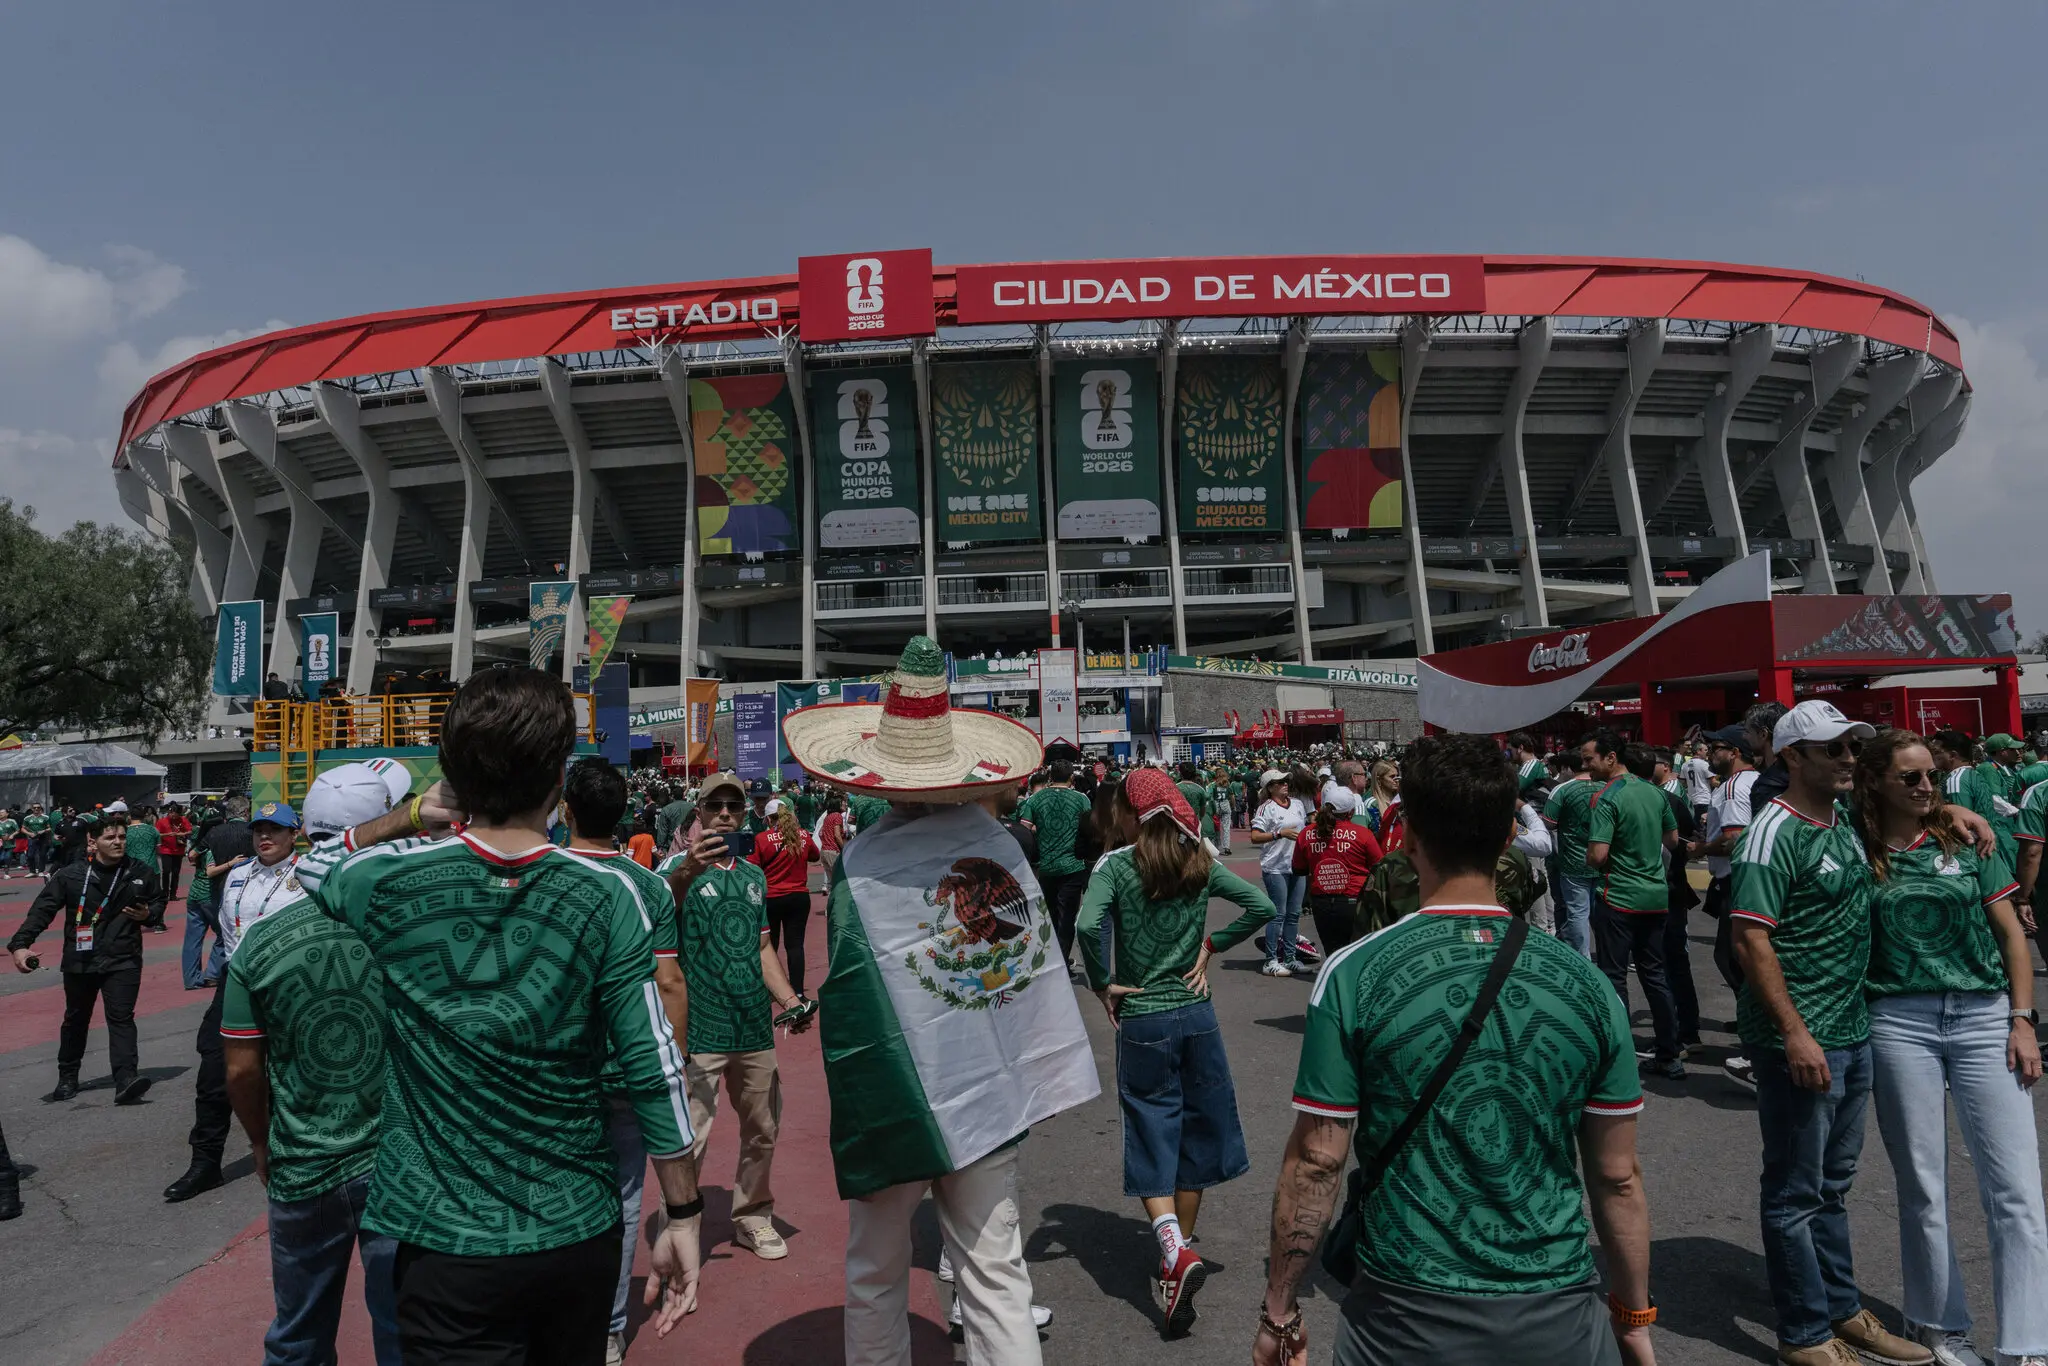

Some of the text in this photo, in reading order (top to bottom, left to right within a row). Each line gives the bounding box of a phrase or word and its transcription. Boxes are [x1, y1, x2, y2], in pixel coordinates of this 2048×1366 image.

[993, 267, 1451, 306] CIUDAD DE MÉXICO
[611, 298, 779, 331] ESTADIO
[848, 320, 884, 330] 2026
[1096, 434, 1119, 442] FIFA
[854, 443, 877, 452] FIFA
[1082, 452, 1133, 460] WORLD CUP
[840, 461, 892, 476] COPA
[1082, 461, 1134, 472] 2026
[842, 475, 892, 488] MUNDIAL
[842, 487, 894, 500] 2026
[1196, 487, 1266, 502] SOMOS
[948, 494, 1028, 512] WE ARE
[1196, 504, 1266, 516] CIUDAD DE
[948, 512, 1028, 526] MEXICO CITY
[234, 616, 240, 626] DE
[234, 627, 239, 637] LA
[1528, 632, 1590, 672] Coca-Cola
[988, 658, 1039, 672] SOMO
[1086, 656, 1099, 668] DE
[1328, 669, 1356, 682] FIFA
[1359, 671, 1408, 684] WORLD
[648, 706, 685, 723] MUND
[1253, 730, 1274, 738] Coca-Cola
[1688, 770, 1695, 787] 9
[1310, 842, 1327, 853] TOP
[1337, 842, 1350, 853] UP
